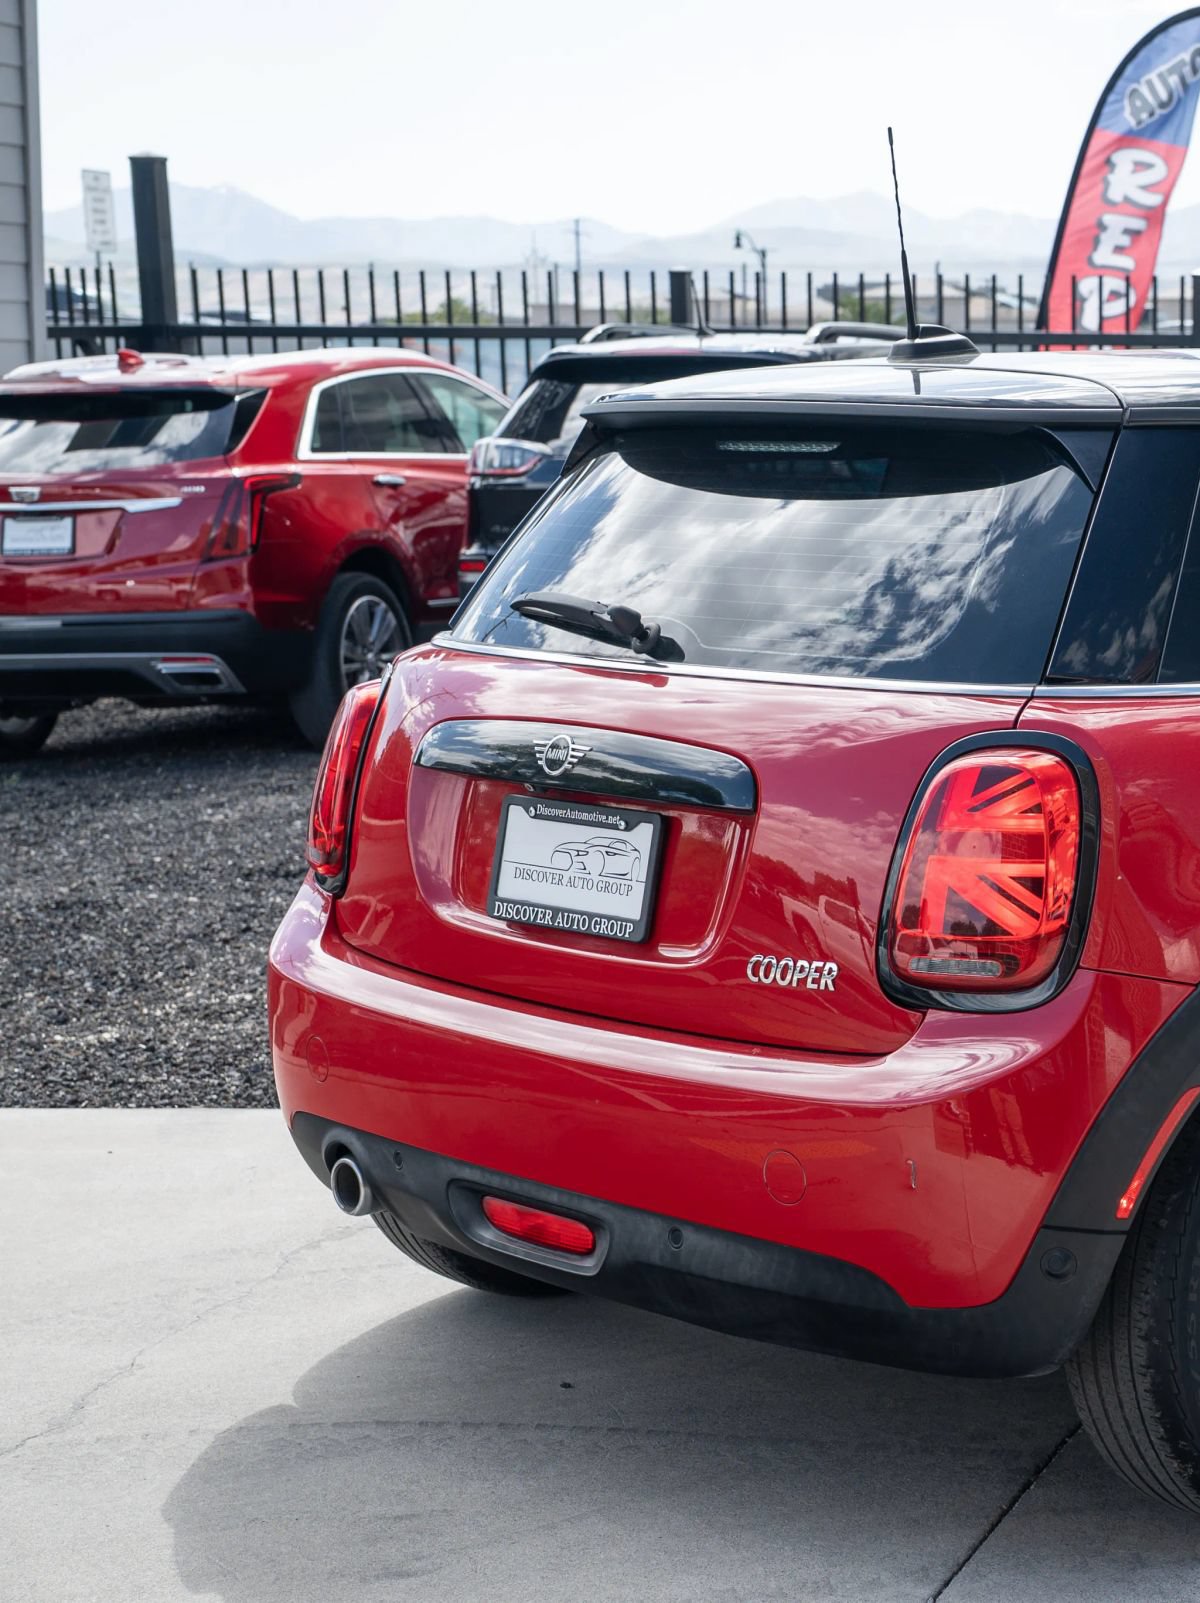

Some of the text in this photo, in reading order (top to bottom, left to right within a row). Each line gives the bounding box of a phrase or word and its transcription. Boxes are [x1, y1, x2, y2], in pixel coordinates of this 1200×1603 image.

[1077, 148, 1168, 349] REP
[546, 747, 568, 761] MINI
[536, 804, 620, 825] DiscoverAutomotive.net
[514, 866, 633, 897] DISCOVER AUTO GROUP
[494, 901, 634, 938] DISCOVER AUTO GROUP
[746, 954, 838, 992] COOPER
